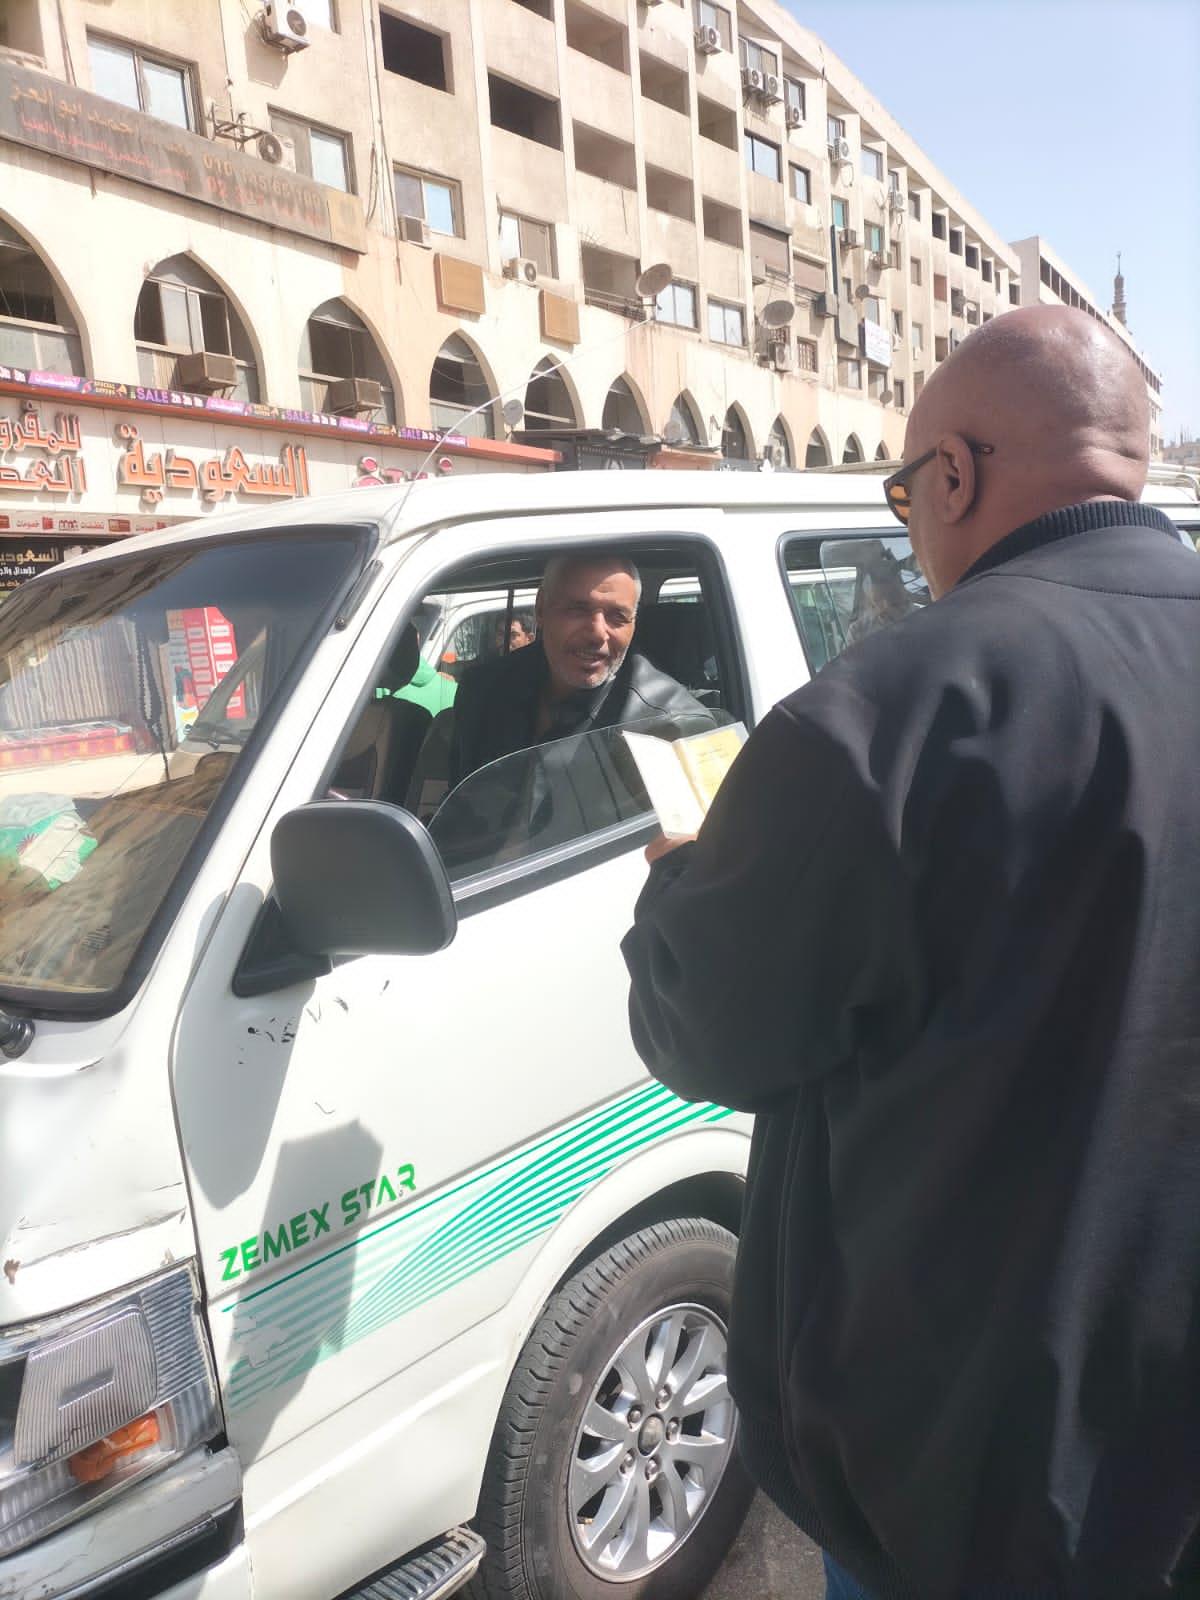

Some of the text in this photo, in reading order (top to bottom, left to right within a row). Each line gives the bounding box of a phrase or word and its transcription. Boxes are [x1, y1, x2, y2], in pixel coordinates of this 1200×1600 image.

[136, 387, 169, 404] SALE
[286, 409, 311, 423] SALE
[0, 400, 81, 453] للمفرو
[401, 428, 422, 441] SALE
[119, 423, 309, 503] السعودية
[0, 547, 59, 566] السعودي
[218, 1163, 417, 1281] ZEMEX STAR
